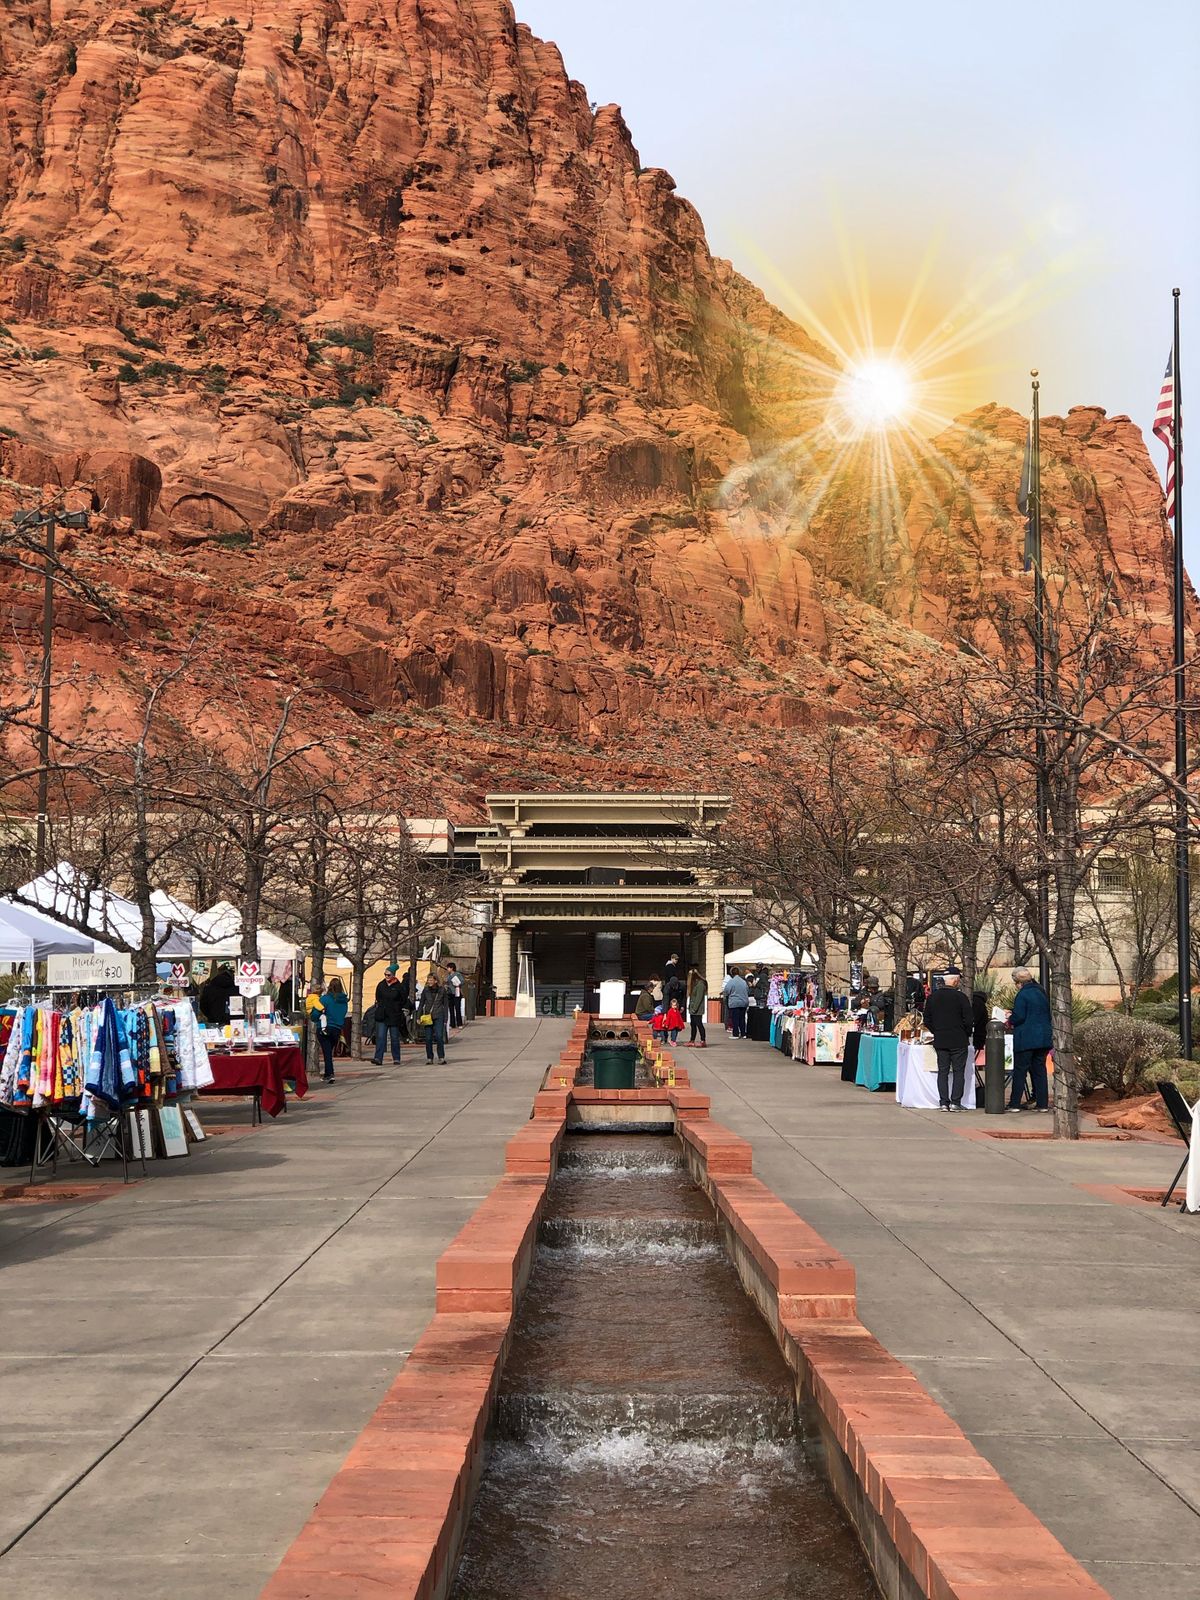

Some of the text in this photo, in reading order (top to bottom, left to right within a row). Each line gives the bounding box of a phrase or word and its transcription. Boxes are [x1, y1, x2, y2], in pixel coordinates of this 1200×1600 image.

[512, 904, 705, 917] TUACAHN AMPHITHEATRE
[104, 965, 122, 979] $30
